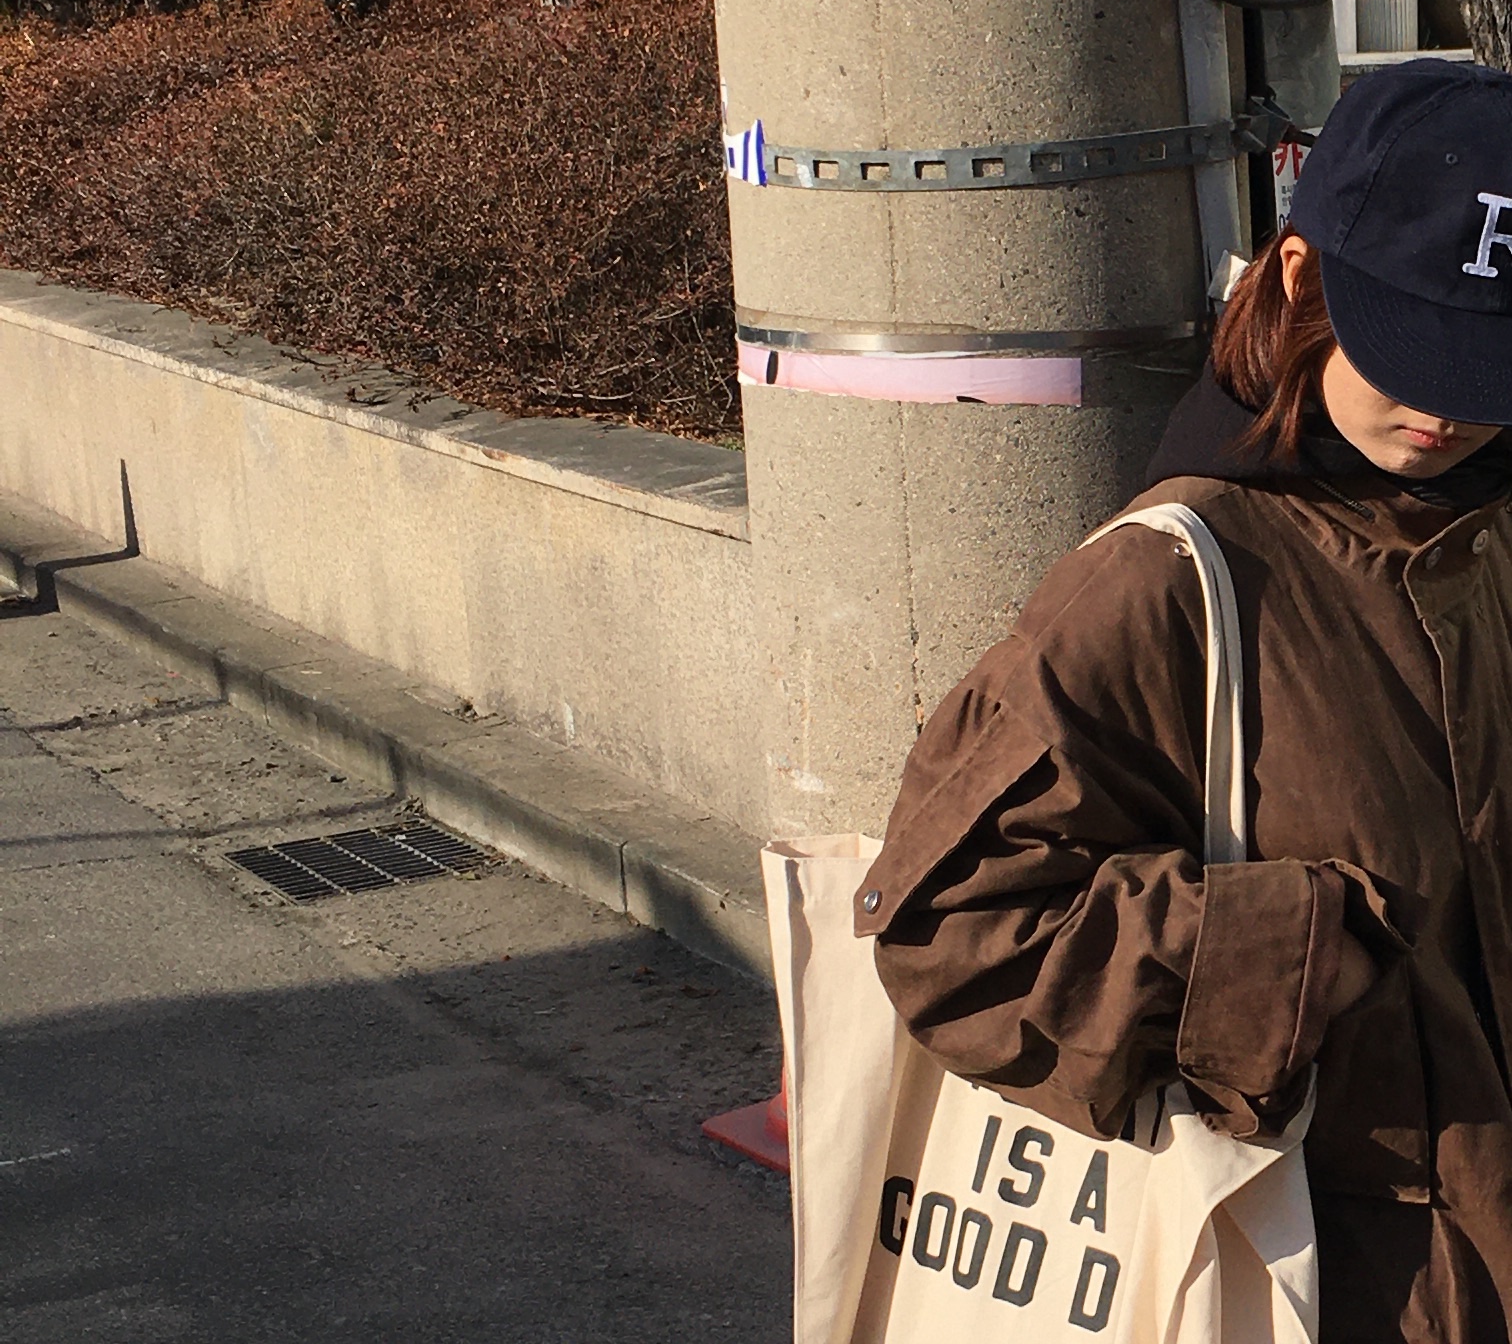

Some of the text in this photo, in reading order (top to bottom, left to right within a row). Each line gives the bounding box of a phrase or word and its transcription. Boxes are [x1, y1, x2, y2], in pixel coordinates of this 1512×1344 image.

[972, 1115, 1055, 1208] IS
[1070, 1149, 1109, 1234] A
[879, 1176, 1048, 1307] GOOD
